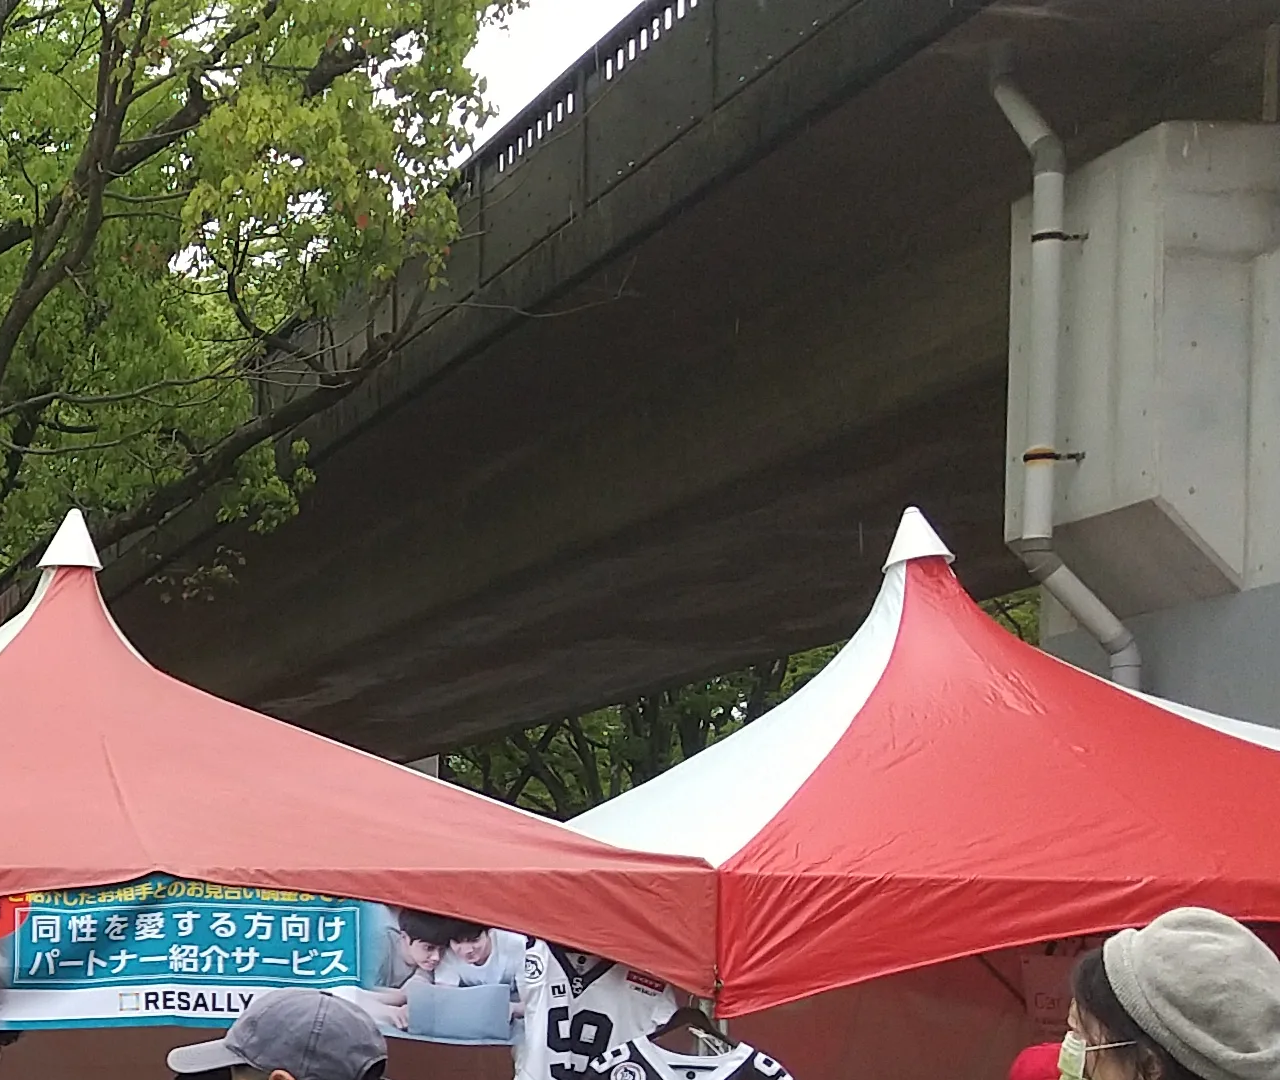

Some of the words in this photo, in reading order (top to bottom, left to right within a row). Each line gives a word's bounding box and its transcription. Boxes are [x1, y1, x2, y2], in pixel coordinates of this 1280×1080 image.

[31, 911, 346, 943] 同性を愛する方向け
[28, 944, 349, 976] パートナー紹介サービス
[144, 990, 255, 1012] RESALLY
